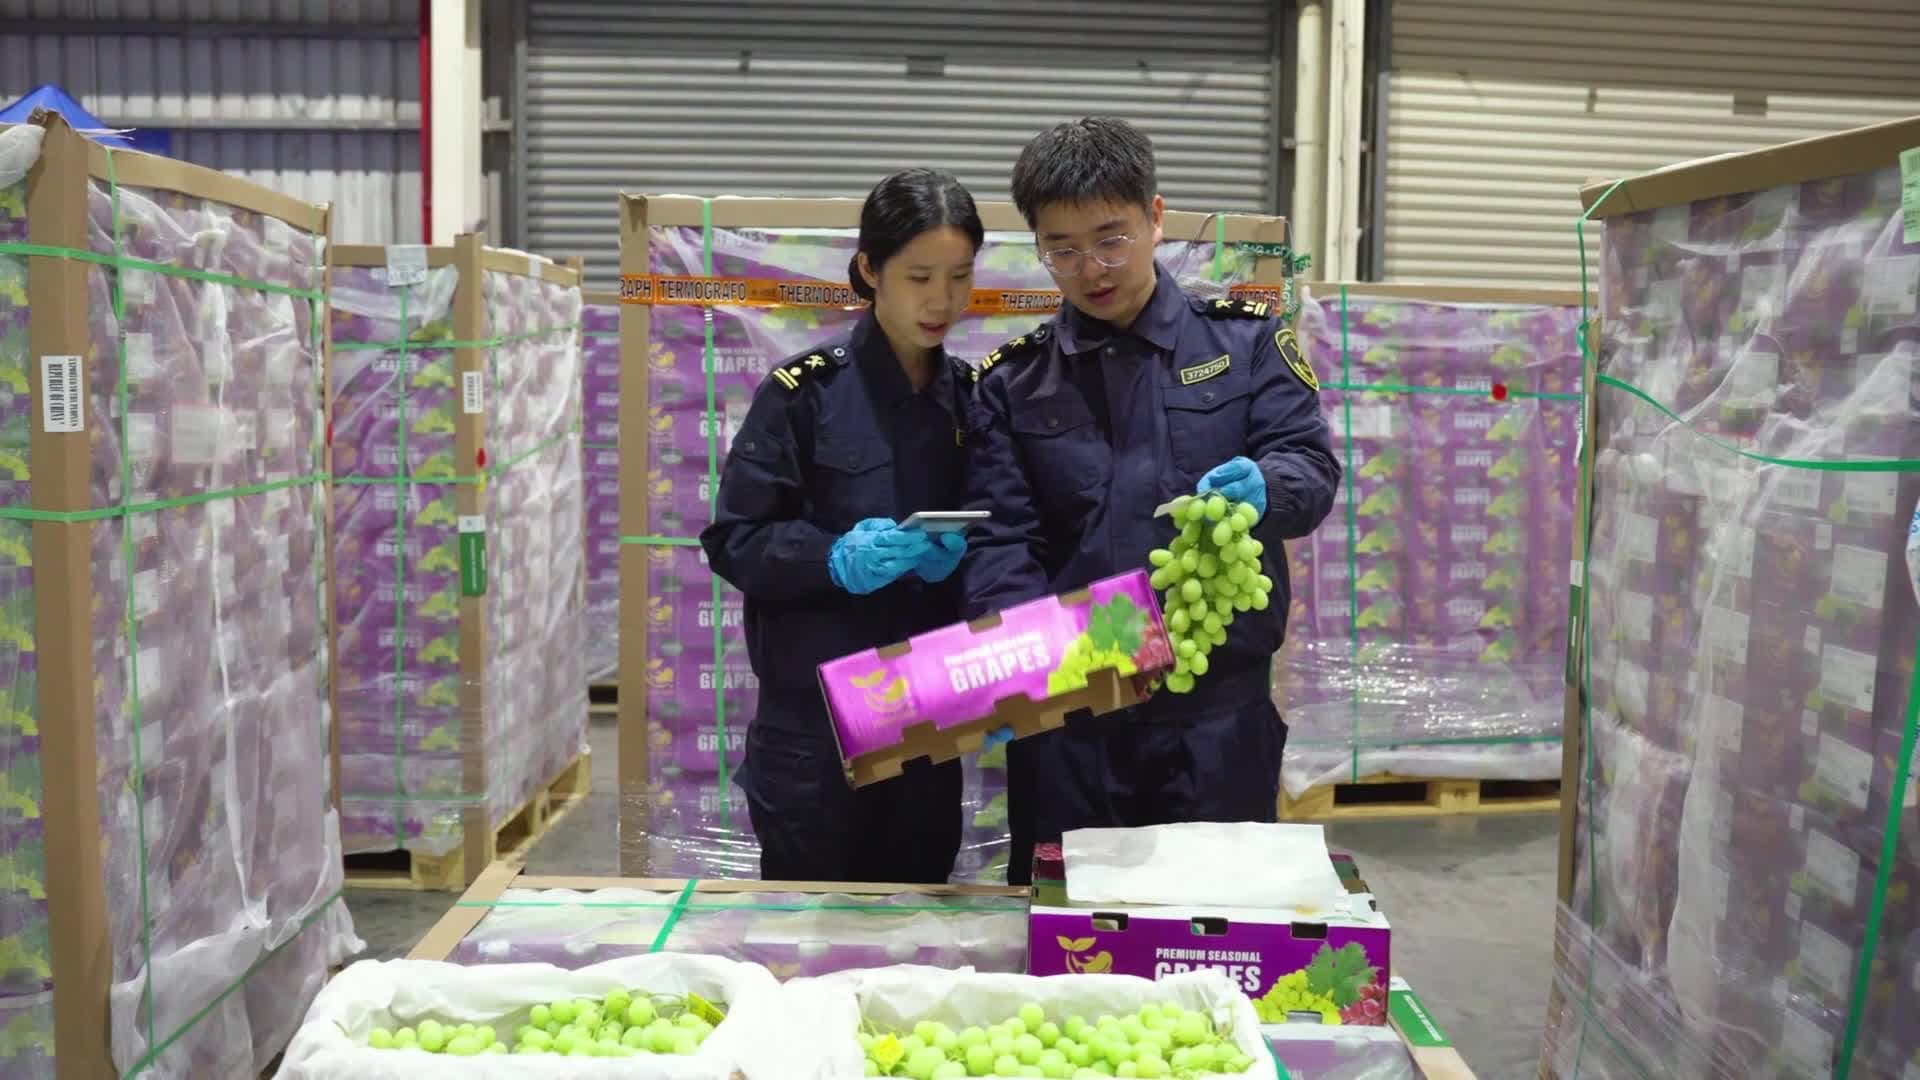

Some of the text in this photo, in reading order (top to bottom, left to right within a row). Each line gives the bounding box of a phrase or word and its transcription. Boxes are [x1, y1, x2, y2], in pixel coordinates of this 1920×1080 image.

[659, 279, 746, 301] TERMOGRAFO
[779, 284, 864, 305] THERMOGRA
[949, 643, 1051, 695] GRAPES
[1156, 948, 1262, 963] PREMIUM SEASONAL
